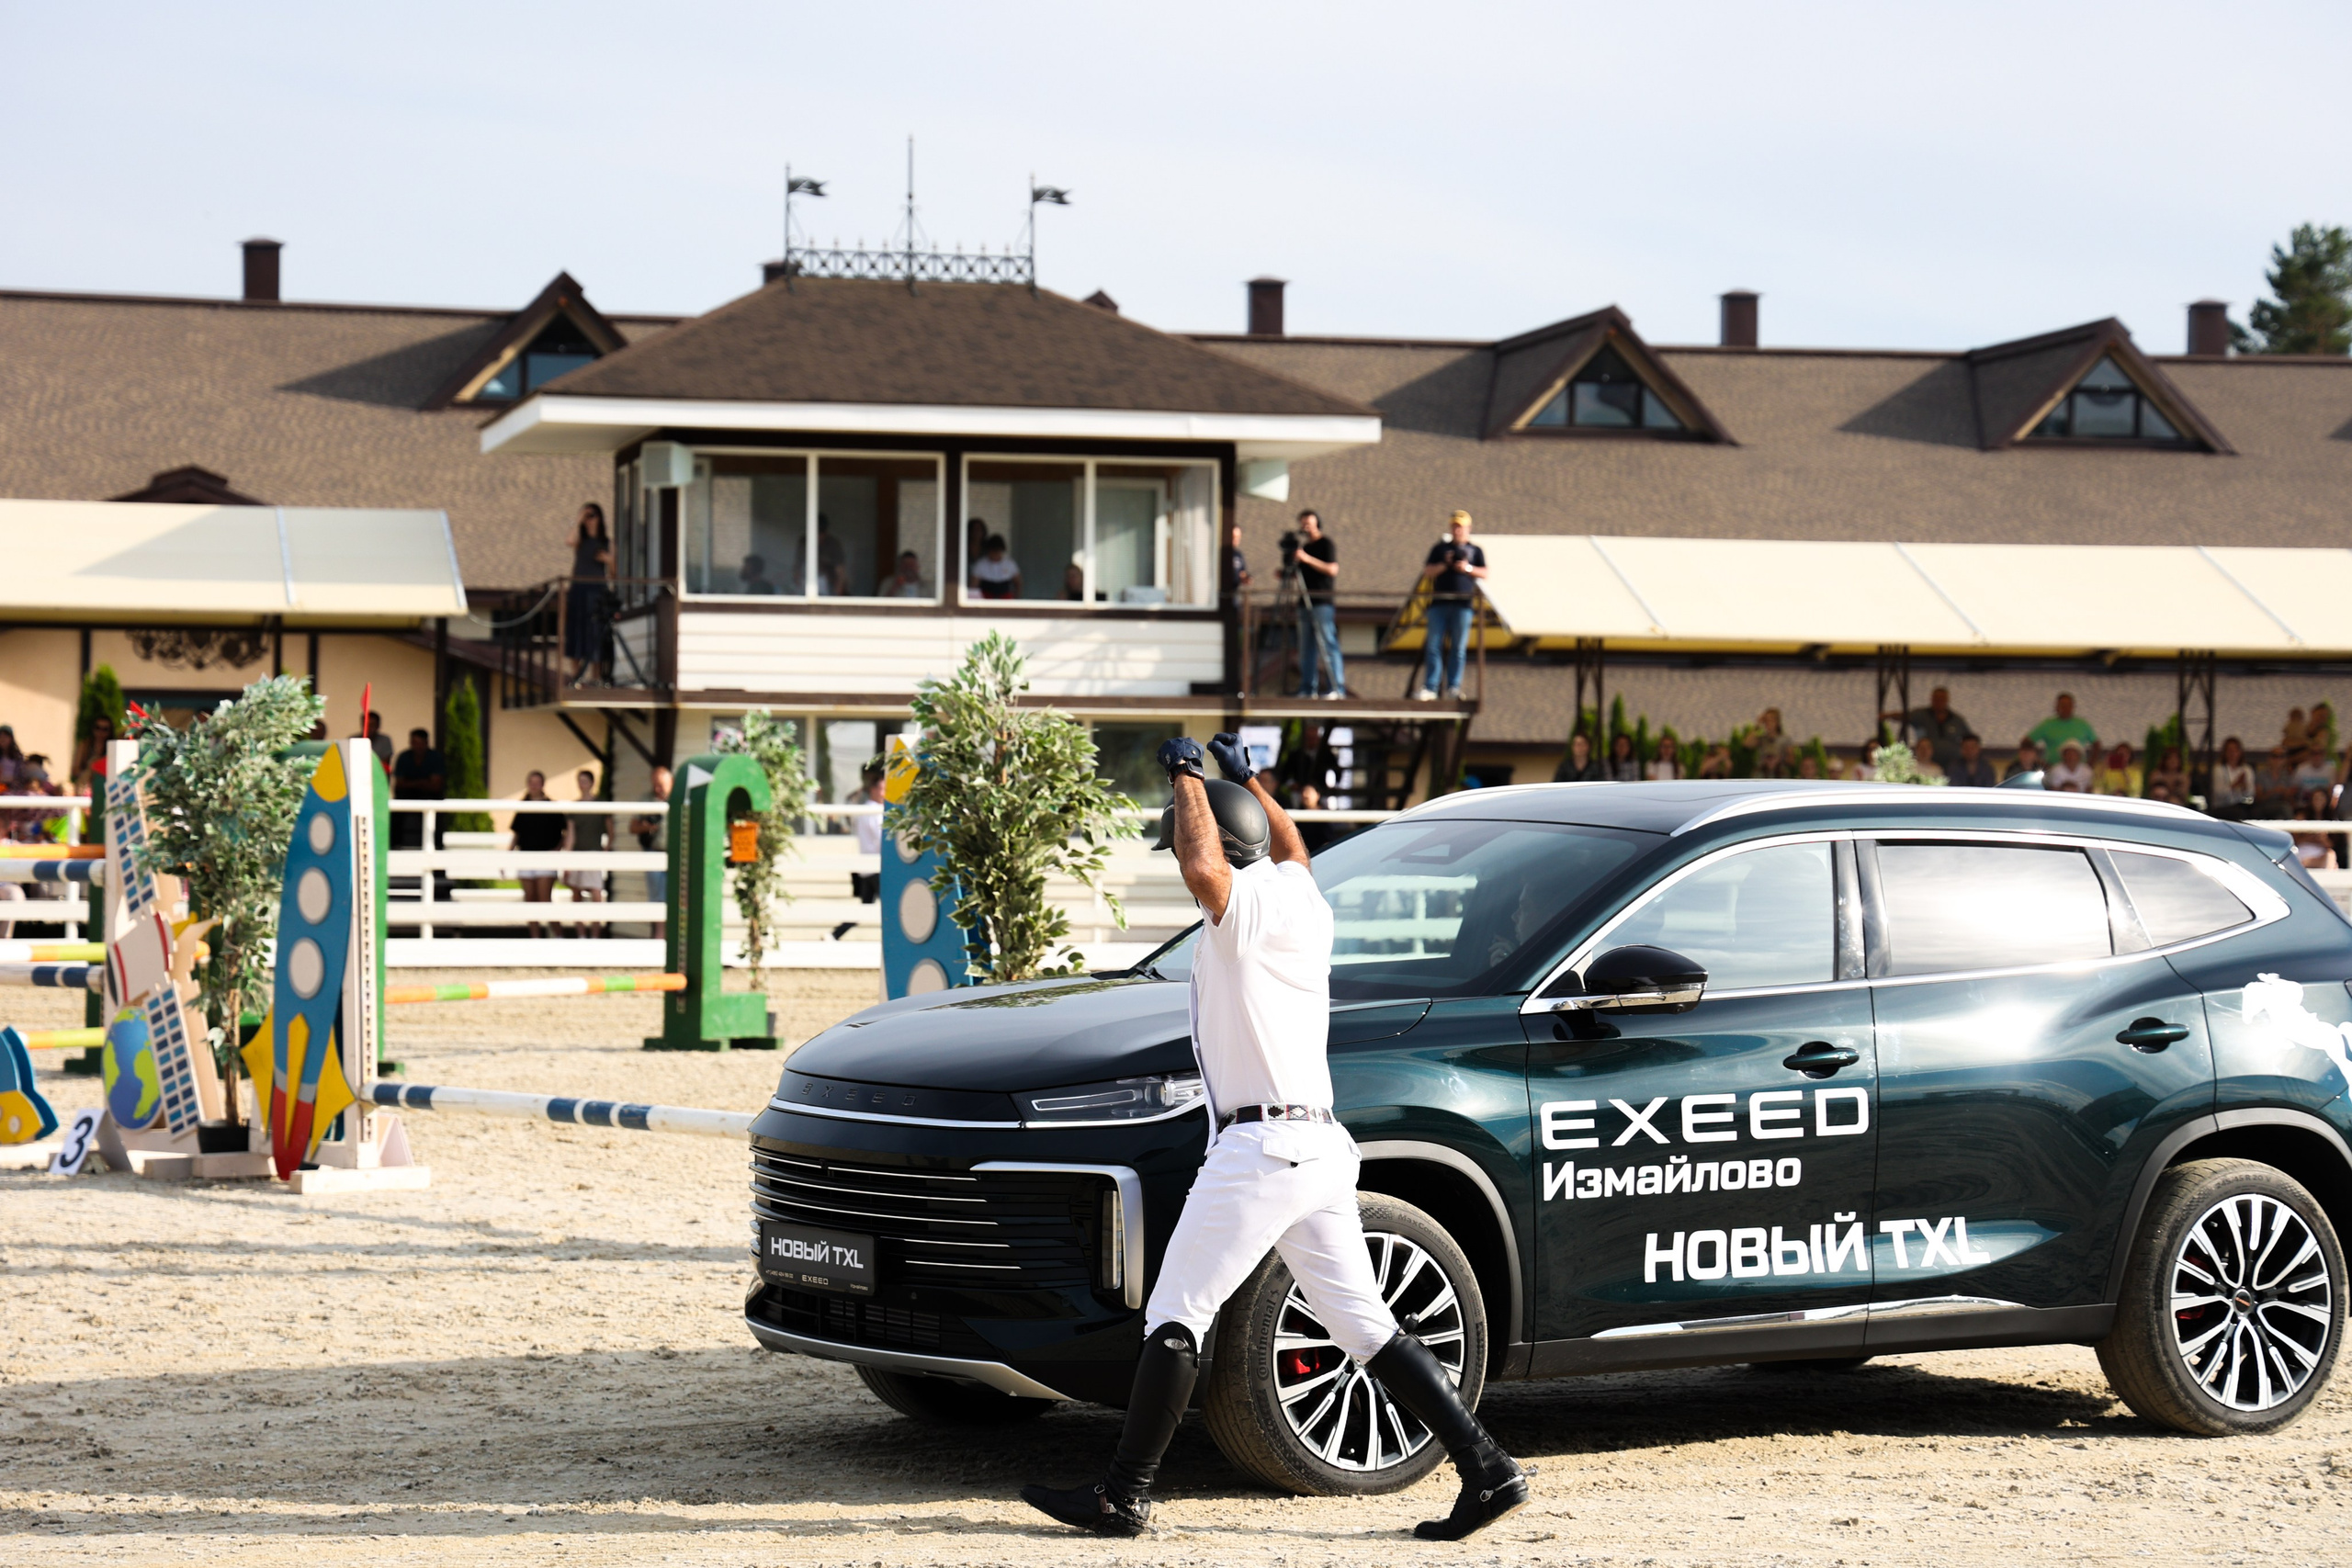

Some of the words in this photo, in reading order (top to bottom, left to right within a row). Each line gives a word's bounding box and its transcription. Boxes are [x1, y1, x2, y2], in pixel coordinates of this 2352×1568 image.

[59, 1115, 93, 1168] 3
[1540, 1087, 1870, 1150] EXEED
[1543, 1155, 1803, 1201] Измайлово
[770, 1236, 830, 1263] НОВЫЙ
[832, 1247, 864, 1269] TXL
[1644, 1212, 1869, 1284] НОВЫЙ
[1879, 1217, 1992, 1269] TXL
[801, 1274, 829, 1286] EXEED
